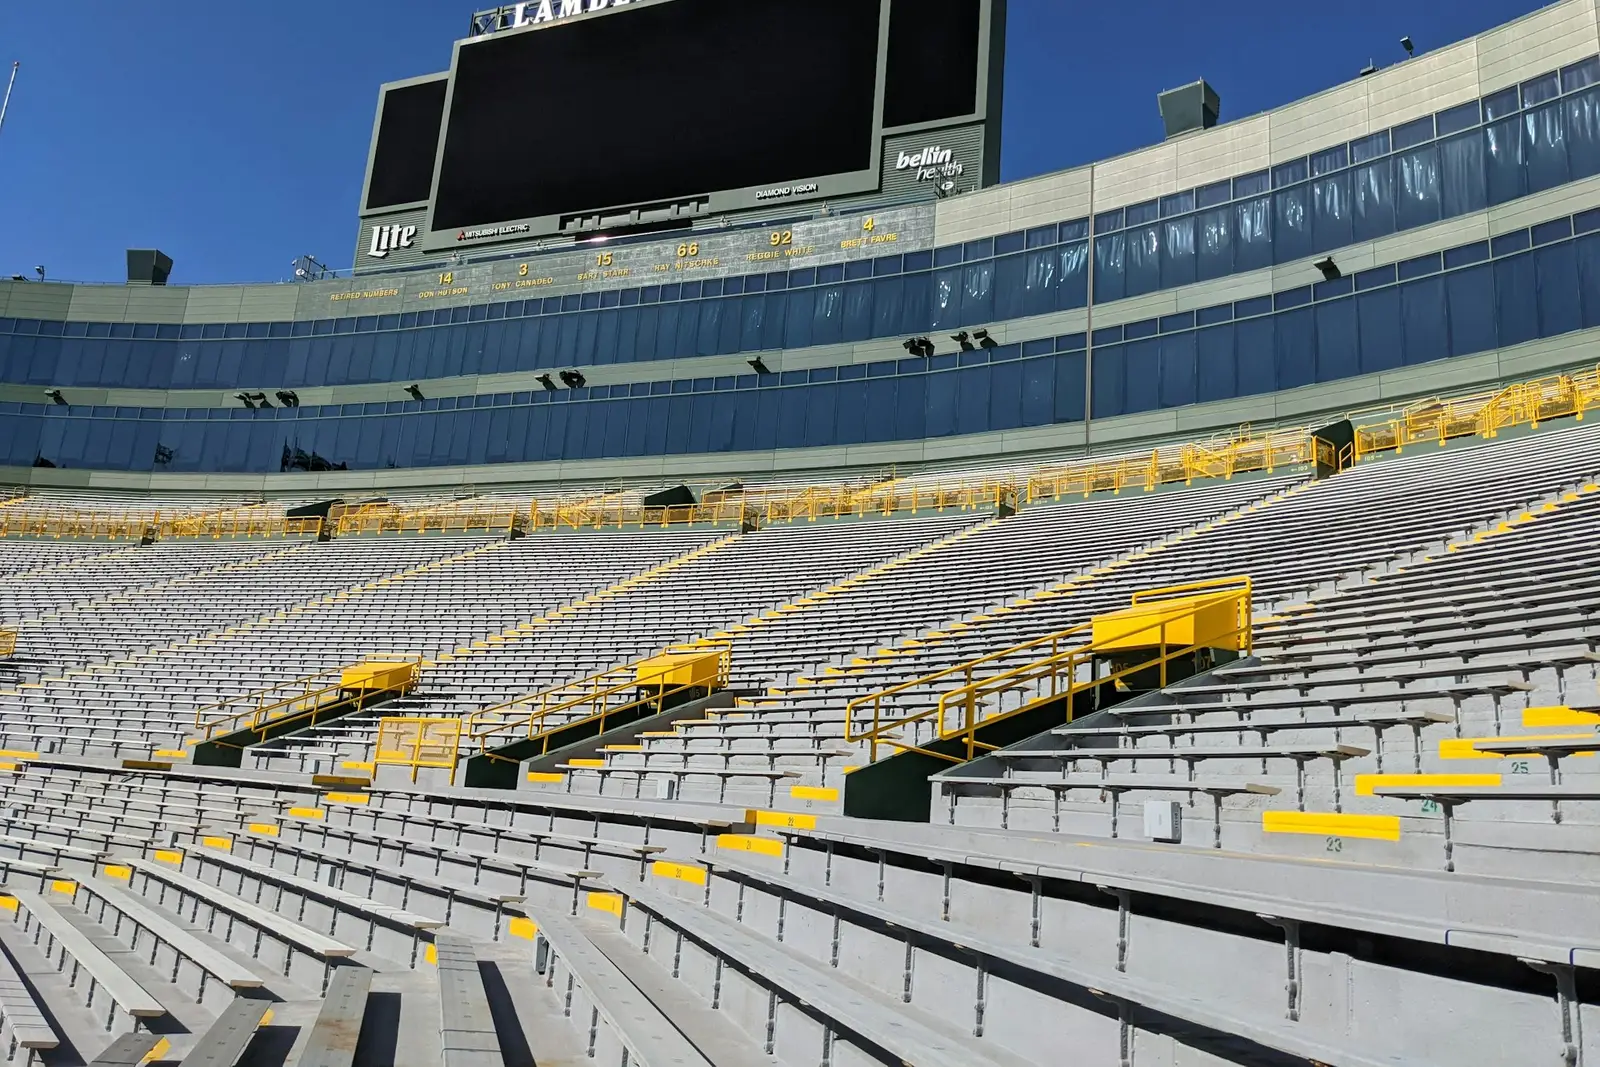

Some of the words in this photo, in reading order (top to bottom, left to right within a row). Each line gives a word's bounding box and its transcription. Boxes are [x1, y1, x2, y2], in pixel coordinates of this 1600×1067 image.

[896, 146, 951, 169] bellin
[755, 187, 790, 199] DIAMOND
[792, 183, 817, 194] VISION
[464, 228, 498, 240] MITSUBISHI
[499, 223, 529, 235] ELECTRIC
[863, 217, 875, 232] 4
[367, 224, 416, 259] Lite
[770, 230, 792, 246] 92
[840, 239, 869, 249] BRETT
[870, 233, 897, 244] FAVRE
[677, 242, 699, 258] 66
[785, 245, 813, 257] WHITE
[596, 252, 613, 267] 15
[518, 263, 528, 277] 3
[438, 272, 453, 285] 14
[491, 279, 511, 290] TONY
[515, 276, 553, 287] CANADEO
[330, 292, 361, 301] RETIRED
[364, 288, 399, 299] NUMBERS
[438, 286, 468, 297] HUTSON
[1511, 762, 1529, 775] 25
[1420, 800, 1438, 813] 24
[1326, 836, 1343, 853] 23
